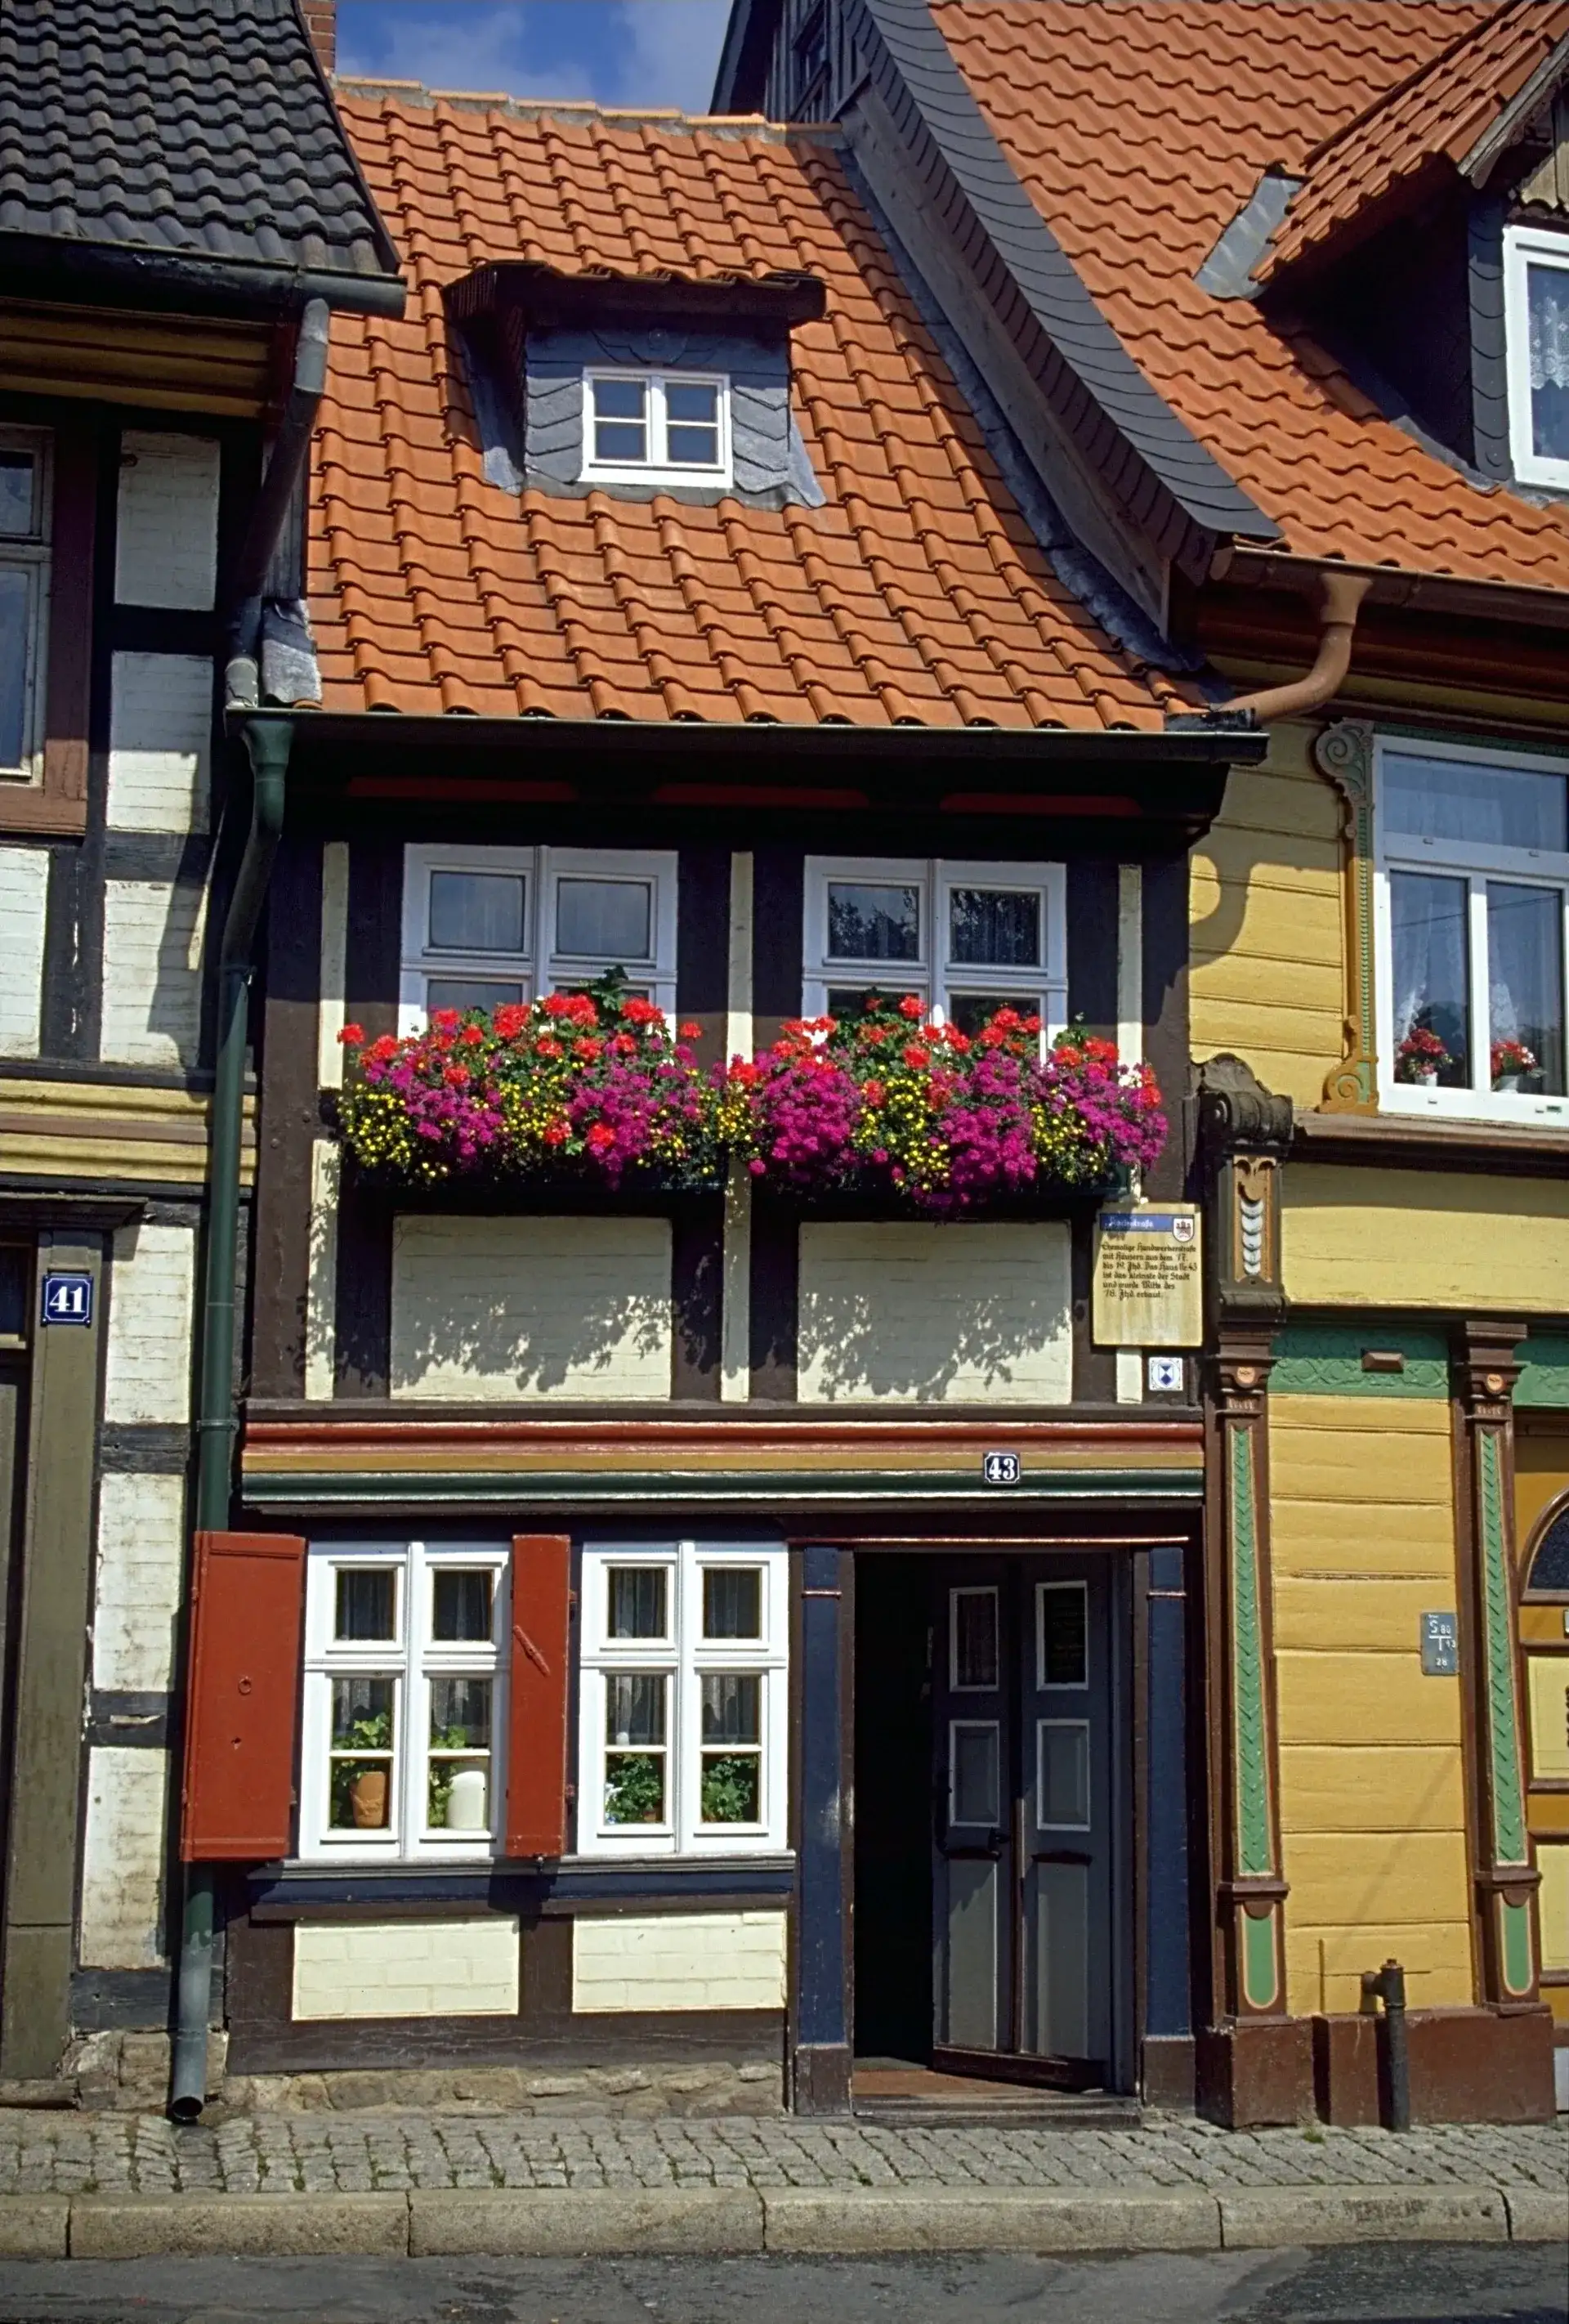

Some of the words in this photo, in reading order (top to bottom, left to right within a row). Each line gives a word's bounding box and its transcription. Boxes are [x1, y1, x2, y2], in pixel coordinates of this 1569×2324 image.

[1160, 1252, 1173, 1261] dem
[1145, 1261, 1158, 1270] Das
[1160, 1261, 1178, 1271] Haus
[1170, 1272, 1191, 1280] Stadt
[1141, 1280, 1161, 1289] Mitte
[1164, 1281, 1175, 1289] des
[49, 1286, 86, 1313] 41
[989, 1457, 1015, 1480] 43
[1428, 1619, 1438, 1633] S
